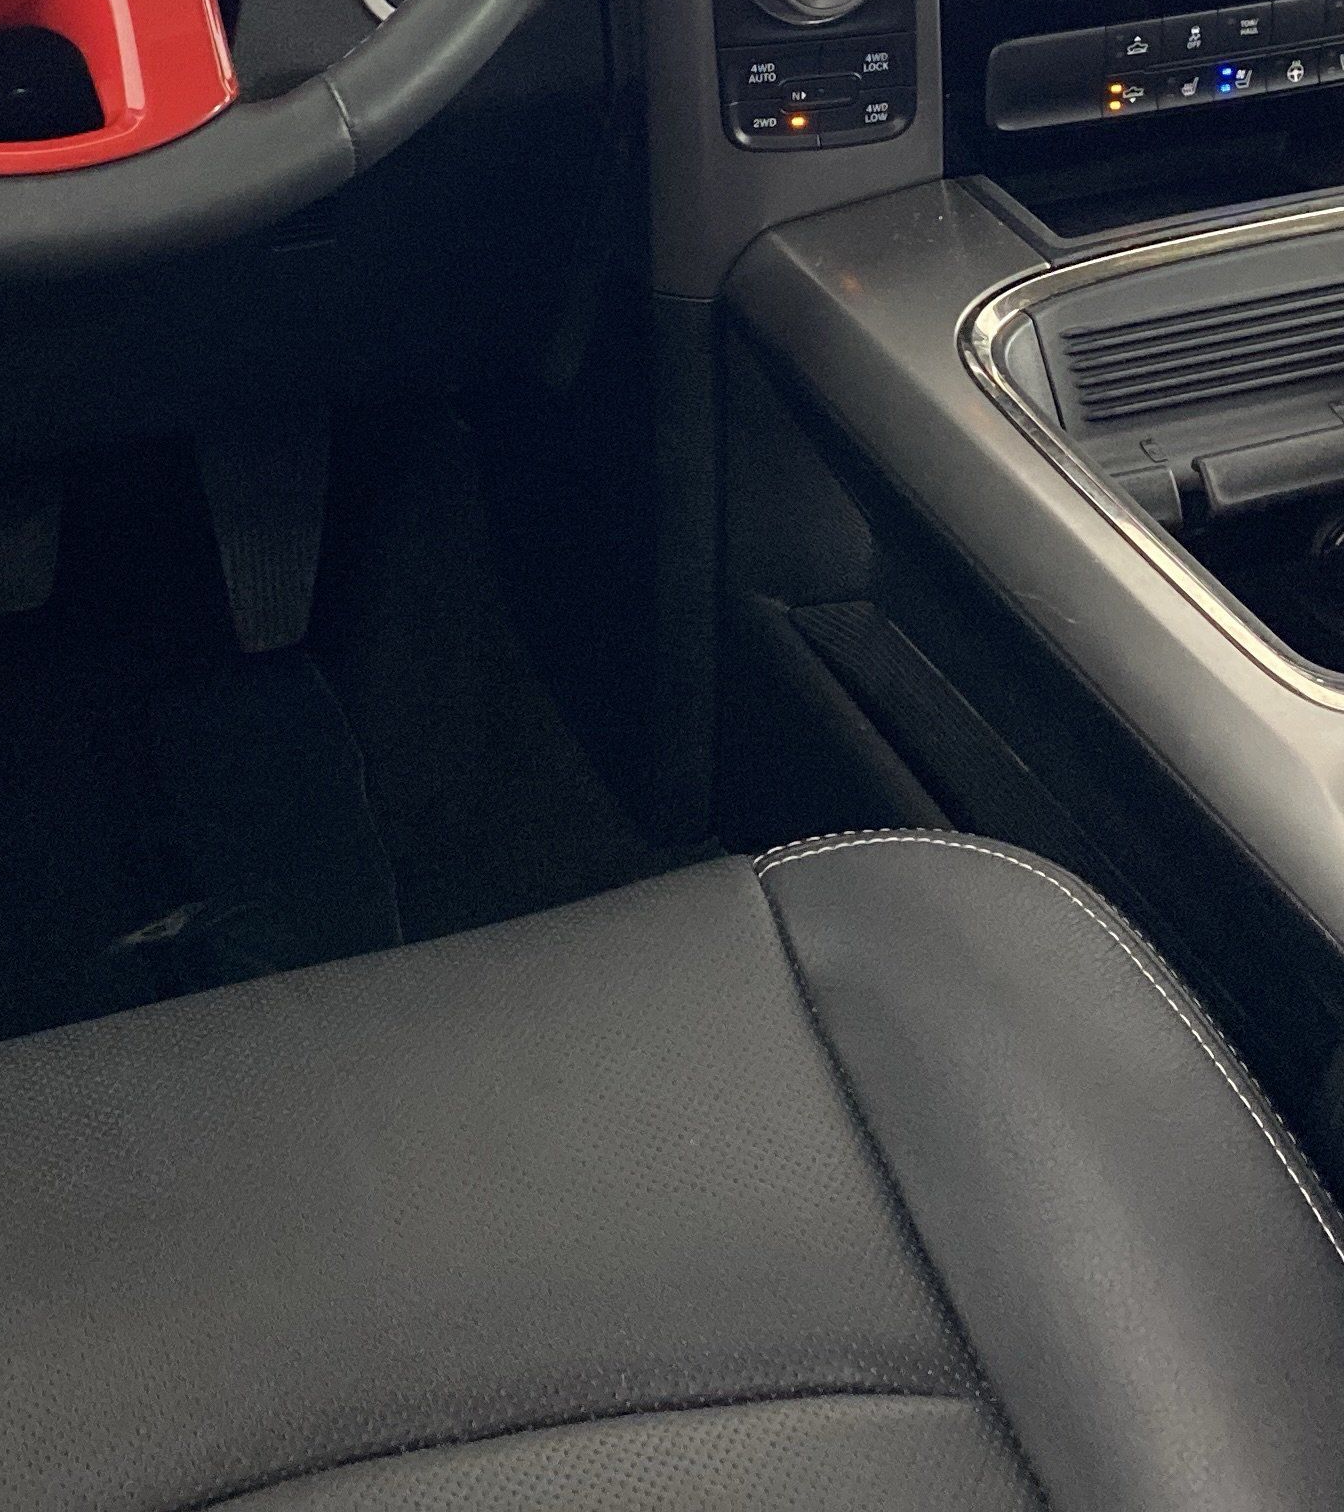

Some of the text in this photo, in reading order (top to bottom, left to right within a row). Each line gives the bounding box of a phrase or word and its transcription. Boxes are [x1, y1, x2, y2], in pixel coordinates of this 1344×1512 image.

[864, 52, 889, 63] 4WD
[750, 63, 775, 74] 4WD
[863, 62, 889, 73] LOCK
[748, 73, 777, 85] AUTO
[865, 102, 889, 114] 4WD
[753, 117, 777, 129] 2WD
[864, 113, 888, 124] LOW
